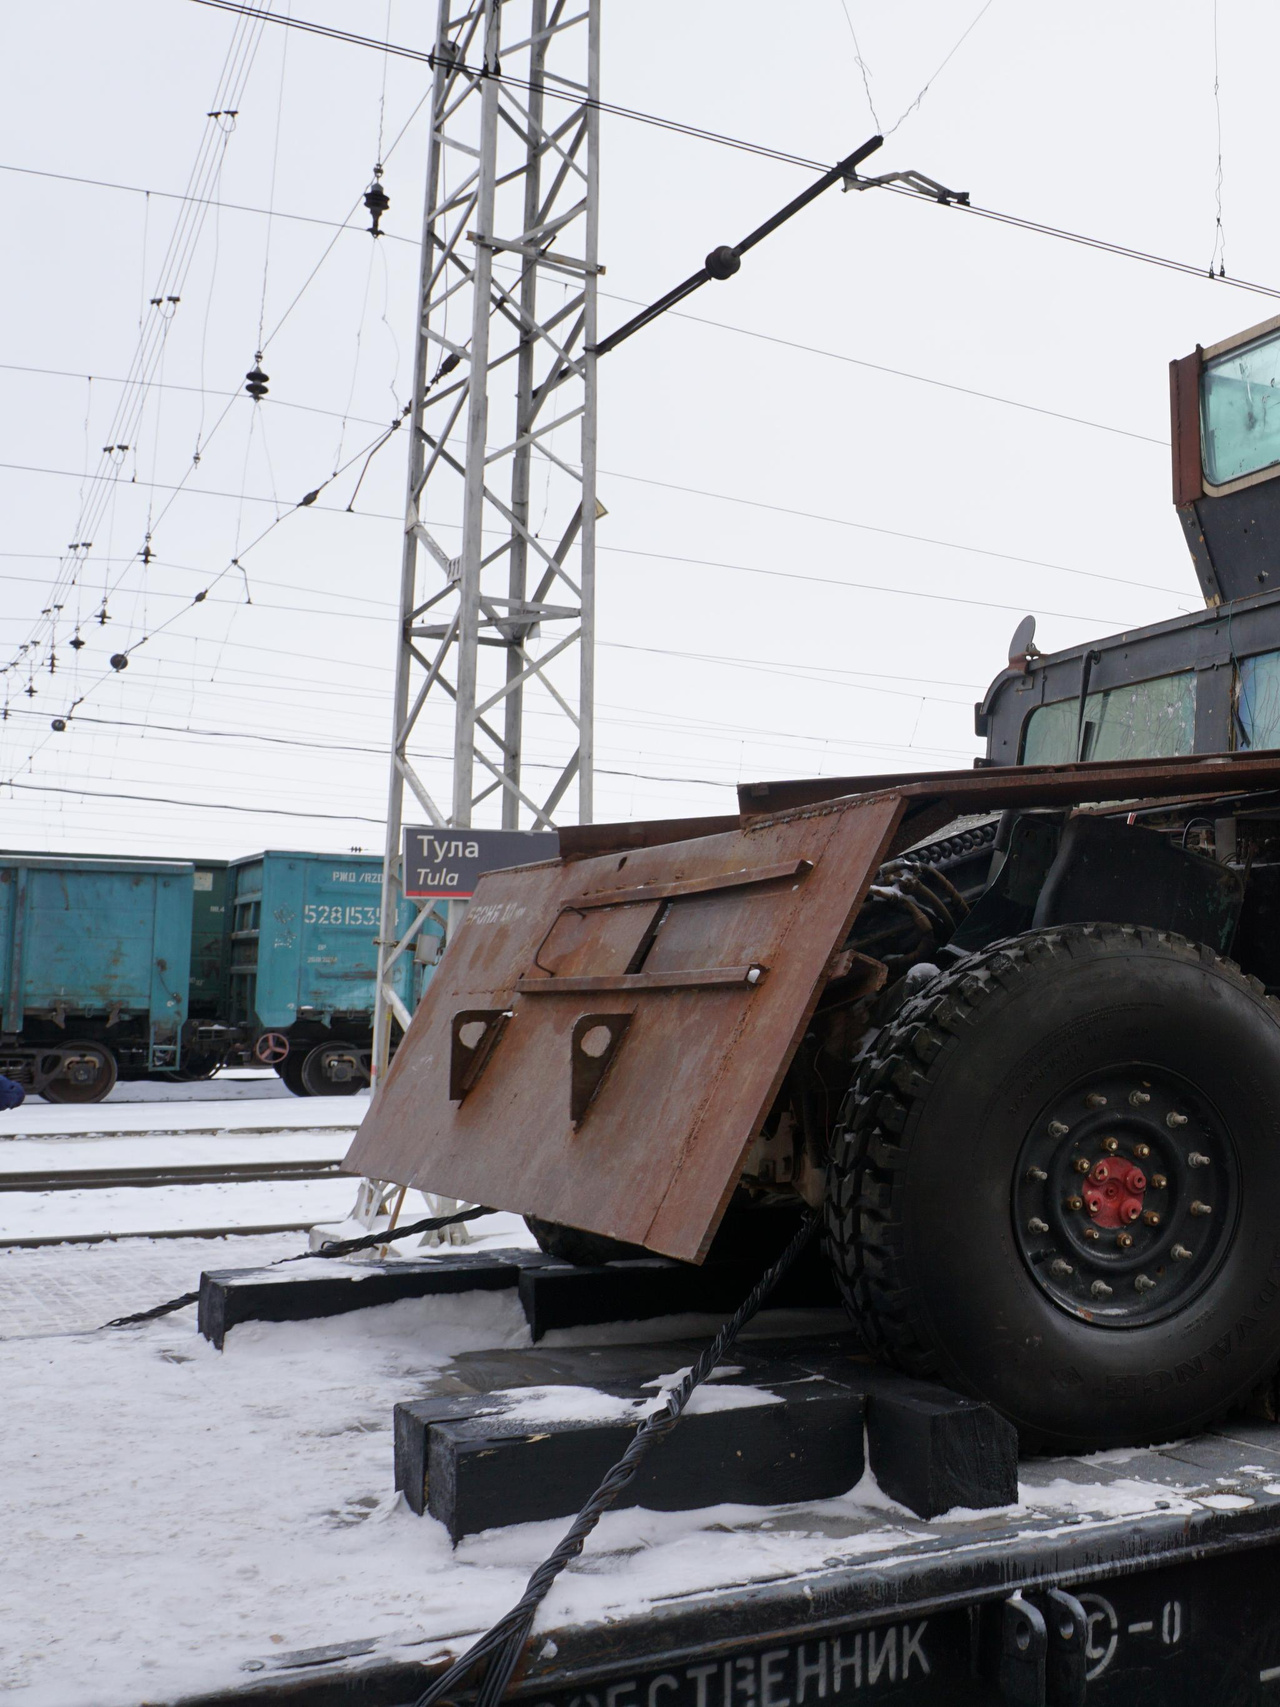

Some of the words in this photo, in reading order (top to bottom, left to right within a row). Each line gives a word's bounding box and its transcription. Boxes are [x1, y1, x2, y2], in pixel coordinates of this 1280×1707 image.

[417, 835, 479, 863] Тула
[333, 871, 356, 883] РЖД
[417, 868, 459, 886] Tula
